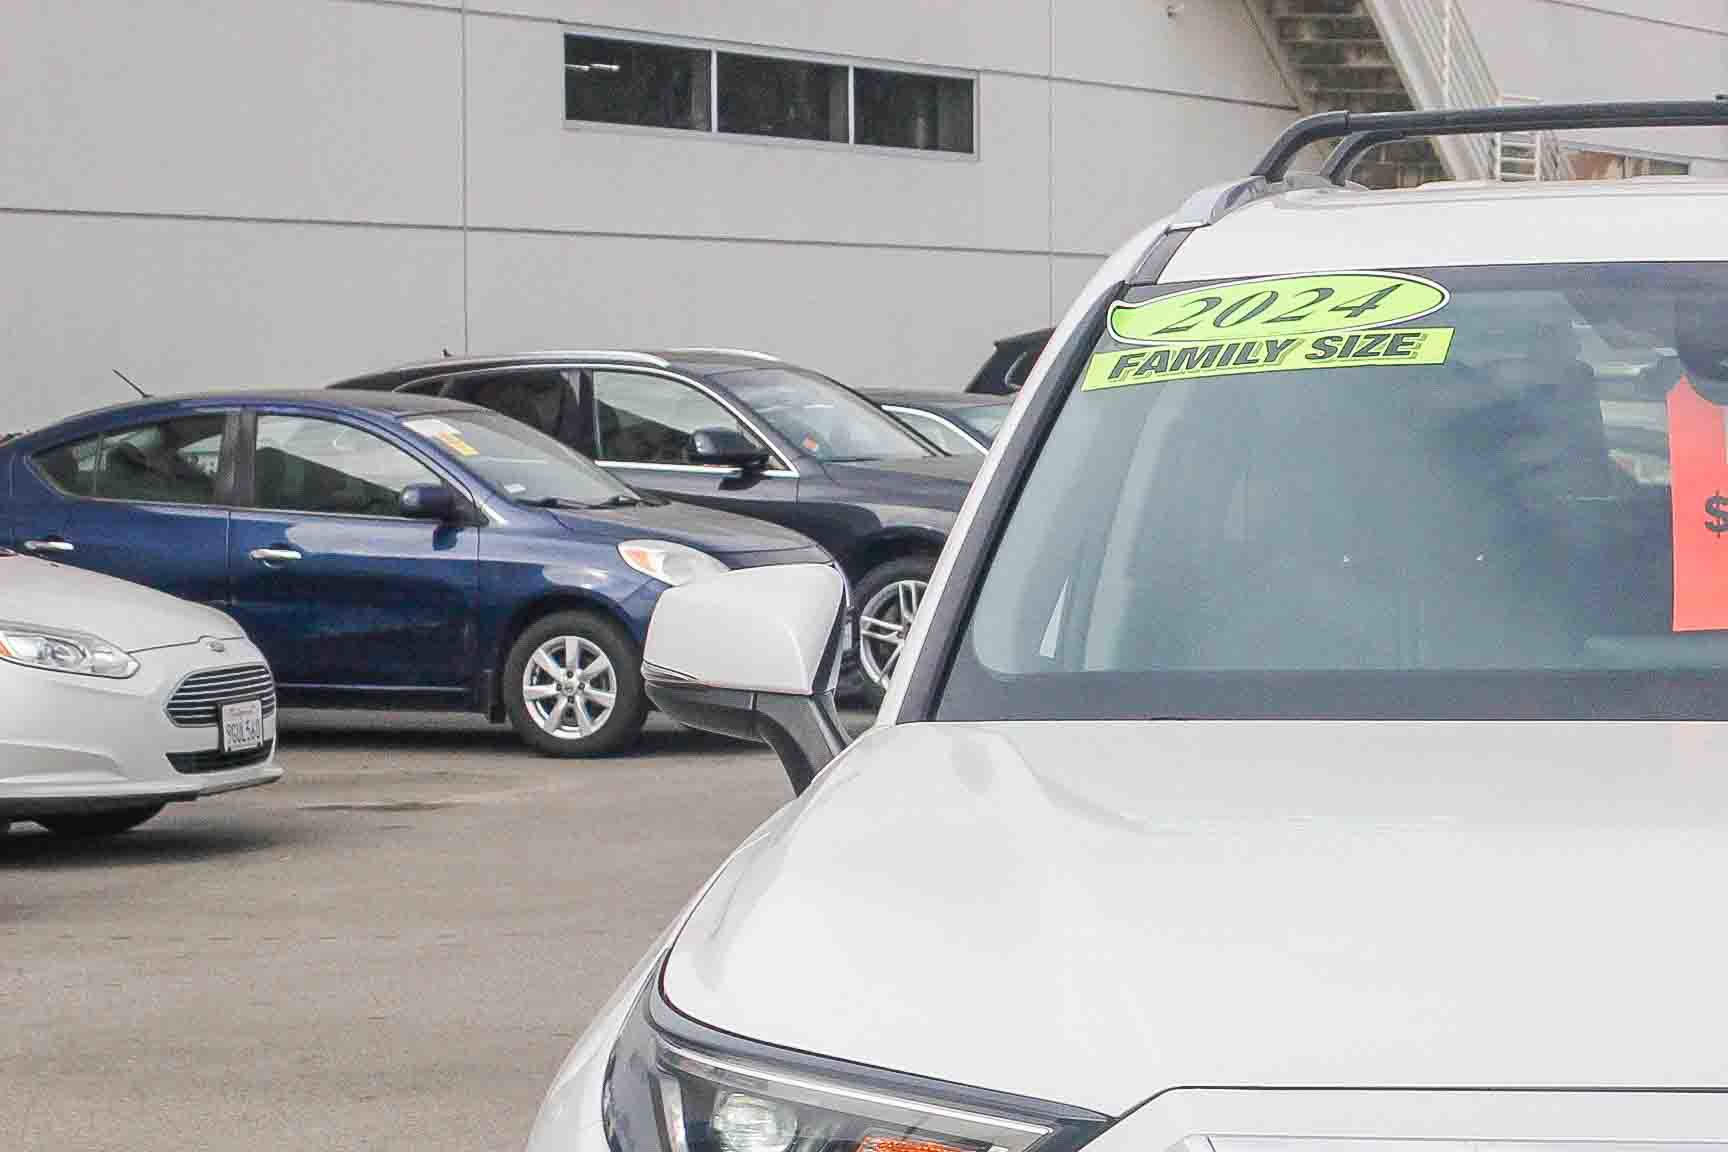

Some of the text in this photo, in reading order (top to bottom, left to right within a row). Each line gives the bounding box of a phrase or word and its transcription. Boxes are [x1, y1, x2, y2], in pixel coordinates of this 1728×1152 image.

[1150, 282, 1404, 337] 2024
[1106, 331, 1425, 382] FAMILY SIZE
